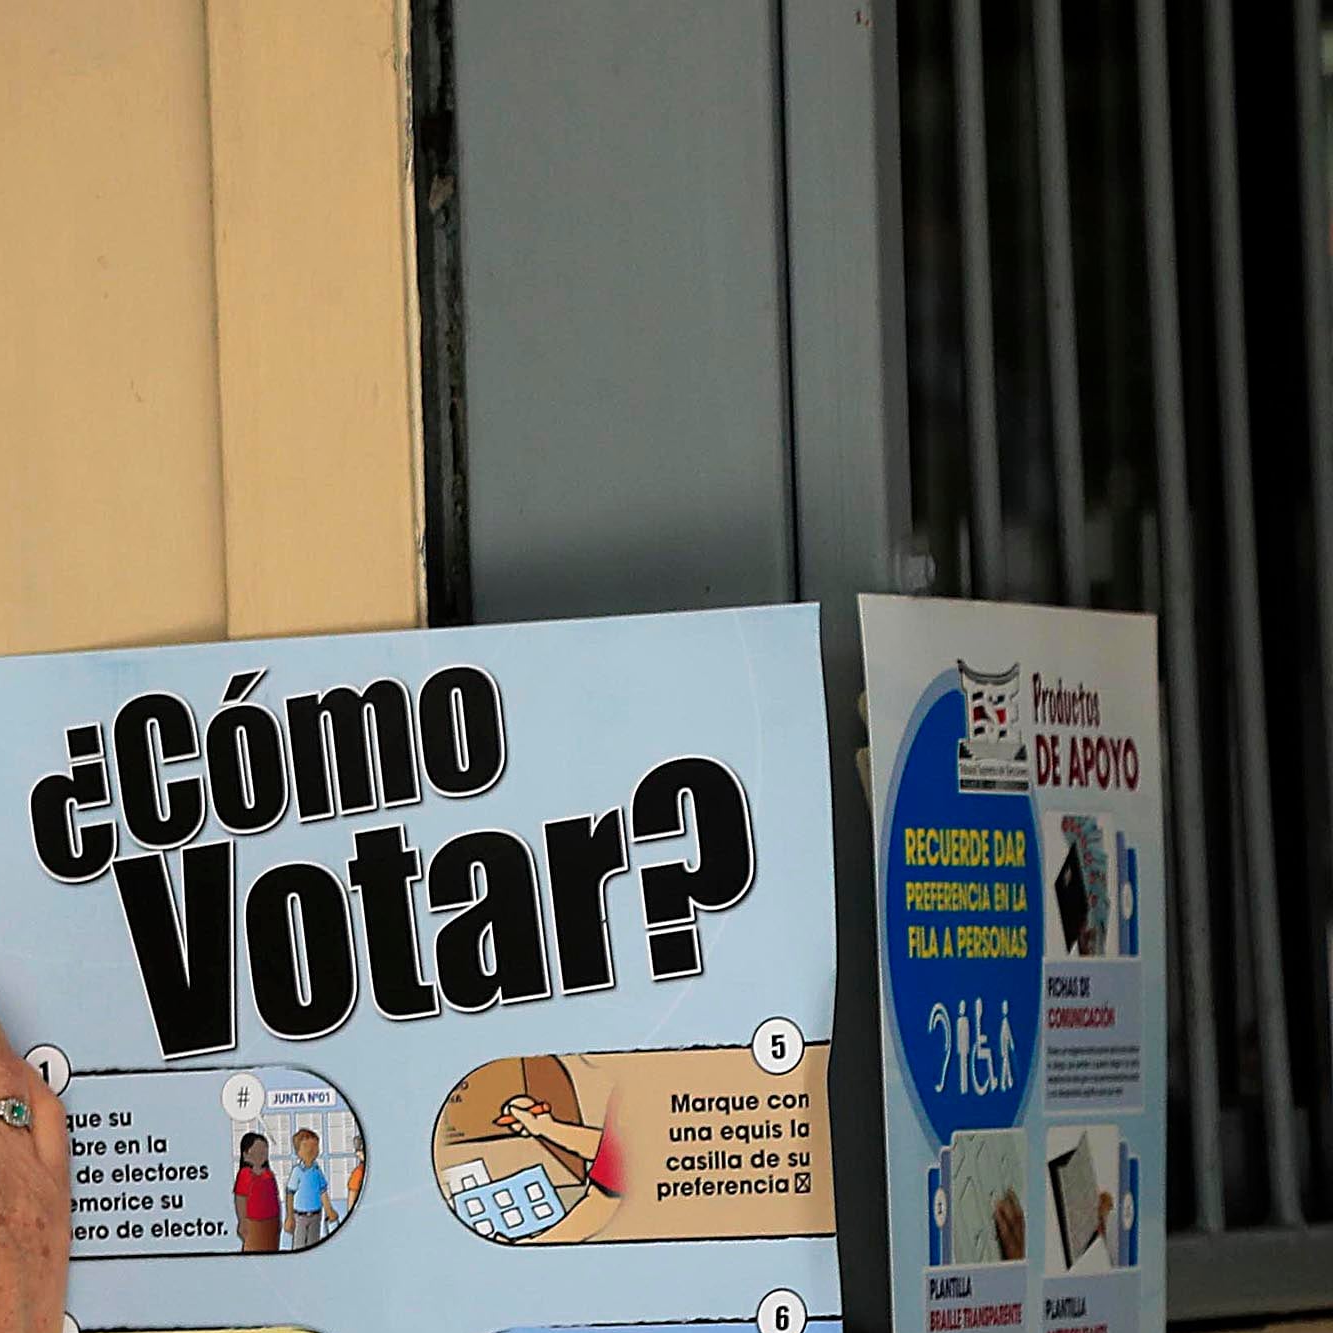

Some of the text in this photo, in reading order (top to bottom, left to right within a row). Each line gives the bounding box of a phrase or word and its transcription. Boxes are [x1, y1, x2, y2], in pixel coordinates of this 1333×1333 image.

[1032, 671, 1101, 728] Productos
[29, 664, 507, 884] ¿Cómo
[1035, 733, 1061, 787] DE
[1068, 735, 1140, 792] APOYO
[904, 827, 1026, 869] RECUERDE DAR
[905, 879, 1028, 912] PREFERENCIA EN LA
[112, 756, 759, 1063] Votar?
[907, 925, 1028, 960] FILA A PERSONAS
[770, 1034, 786, 1060] 5
[272, 1092, 306, 1105] JUNTA
[670, 1092, 811, 1117] Marque con
[108, 1111, 133, 1128] su
[668, 1118, 811, 1146] una equis la
[113, 1138, 141, 1155] en
[147, 1135, 168, 1153] la
[76, 1161, 210, 1184] de electores
[665, 1148, 811, 1171] casilla de su
[656, 1175, 790, 1202] preferencia
[69, 1192, 184, 1213] emorice su
[116, 1219, 145, 1239] de
[150, 1217, 229, 1238] elector.
[774, 1305, 790, 1332] 6
